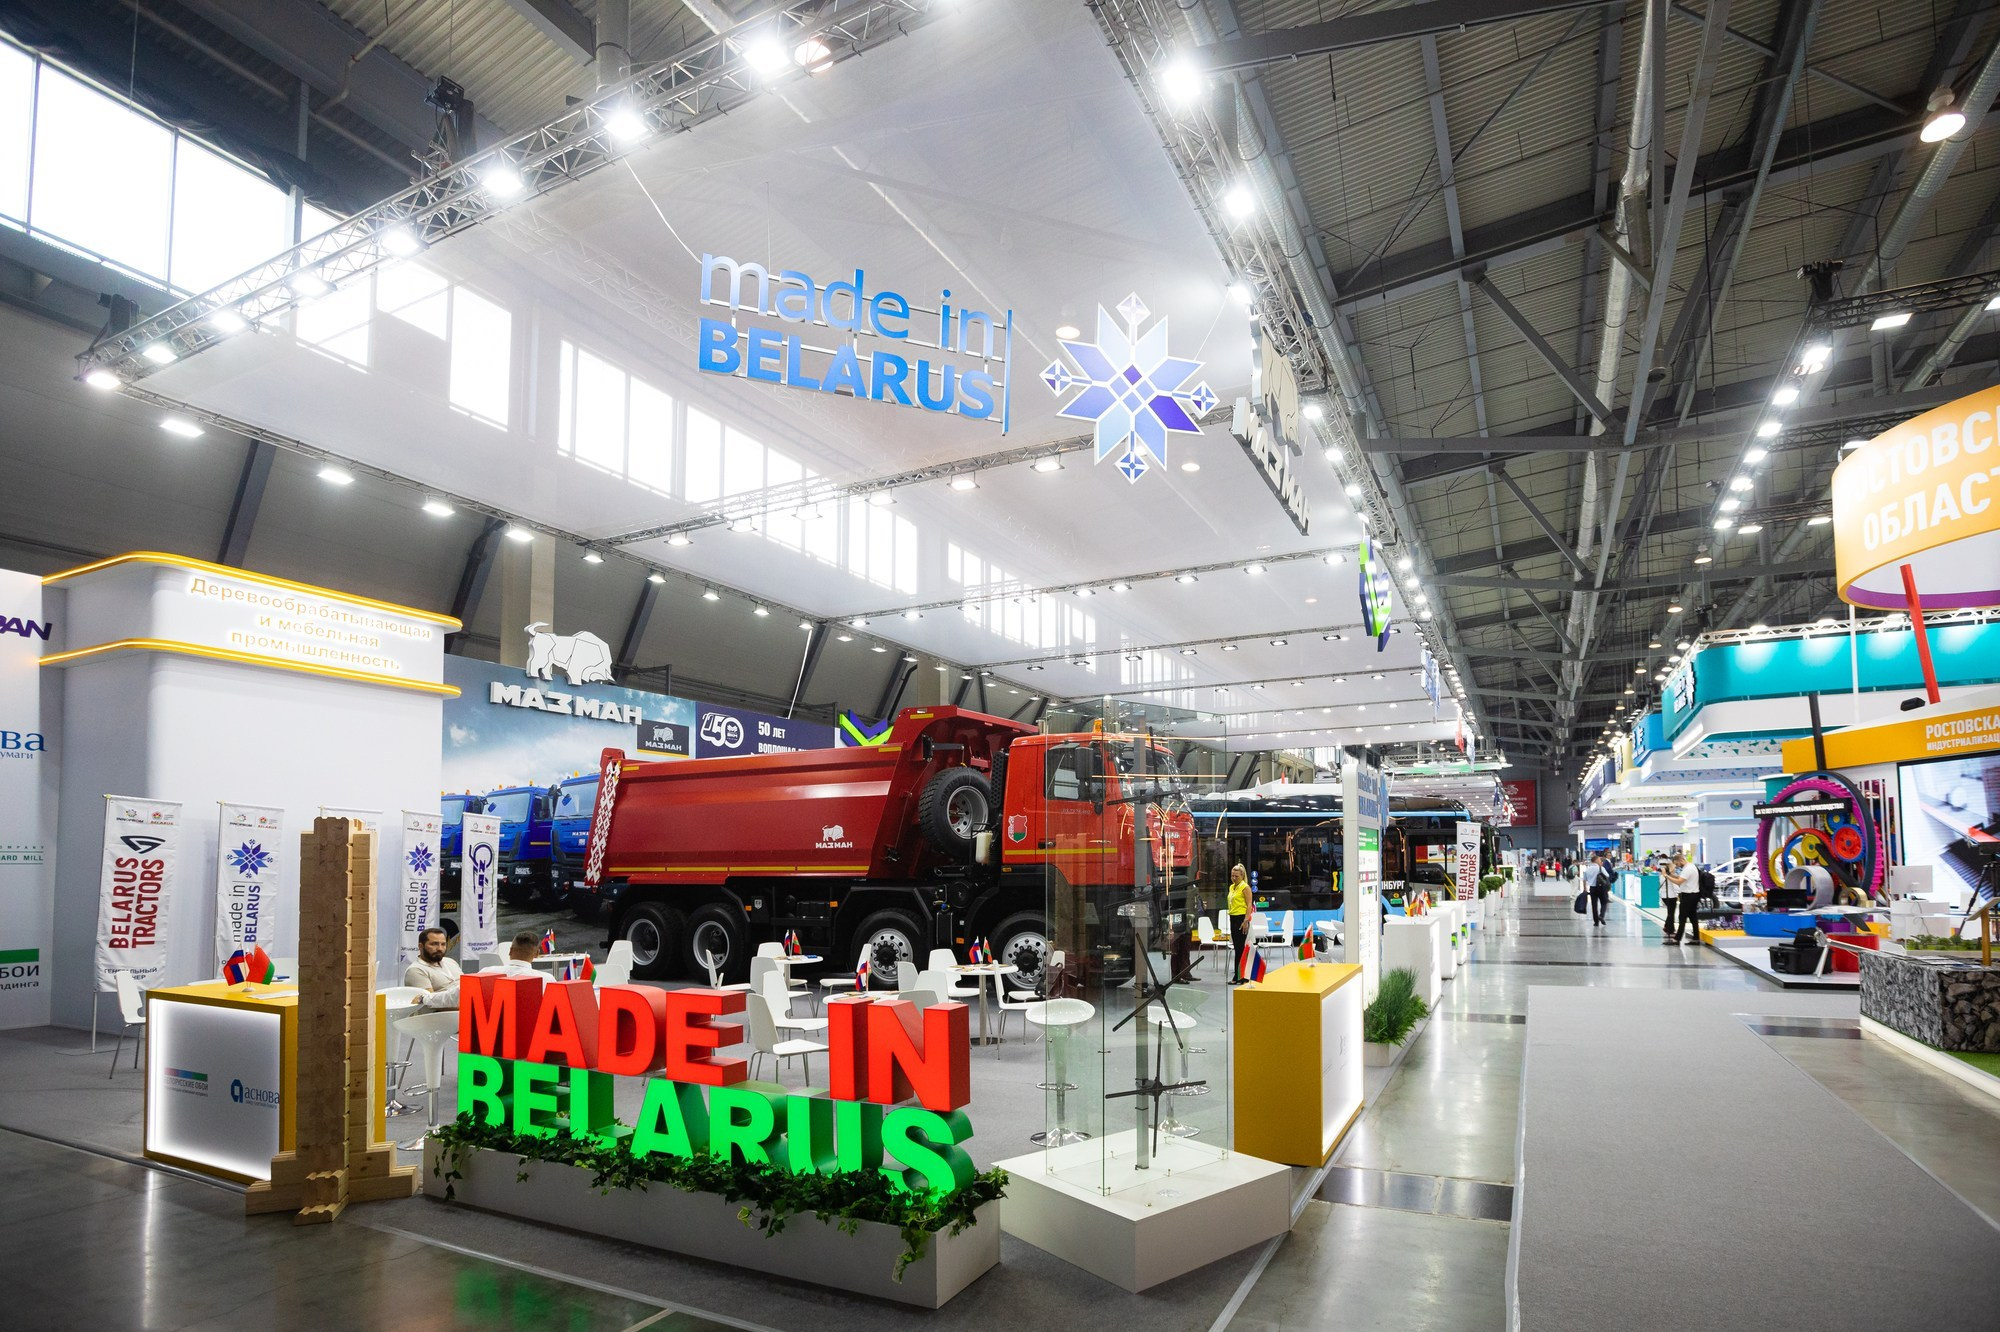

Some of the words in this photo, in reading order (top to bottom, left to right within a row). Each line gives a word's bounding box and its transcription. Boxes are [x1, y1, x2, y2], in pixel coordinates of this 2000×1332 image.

[701, 252, 910, 340] made
[939, 289, 995, 360] in
[698, 317, 996, 420] BELARUS
[1863, 466, 2000, 551] ОБЛАС
[190, 577, 432, 640] Деревообрабатывающая
[259, 616, 271, 628] и
[278, 619, 380, 649] мебельная
[230, 632, 401, 671] промышленность
[758, 721, 771, 739] 50
[772, 726, 786, 739] ЛЕТ
[228, 884, 246, 898] in
[406, 880, 419, 894] in
[1458, 853, 1469, 901] BELARUS
[1467, 854, 1477, 901] TRACTORS
[108, 856, 139, 950] BELARUS
[131, 858, 166, 950] TRACTORS
[228, 902, 244, 943] made
[243, 884, 261, 944] BELARUS
[404, 898, 418, 932] made
[416, 881, 428, 932] BELARUS
[458, 972, 748, 1088] MADE
[829, 997, 971, 1113] IN
[457, 1052, 975, 1206] BELARUS
